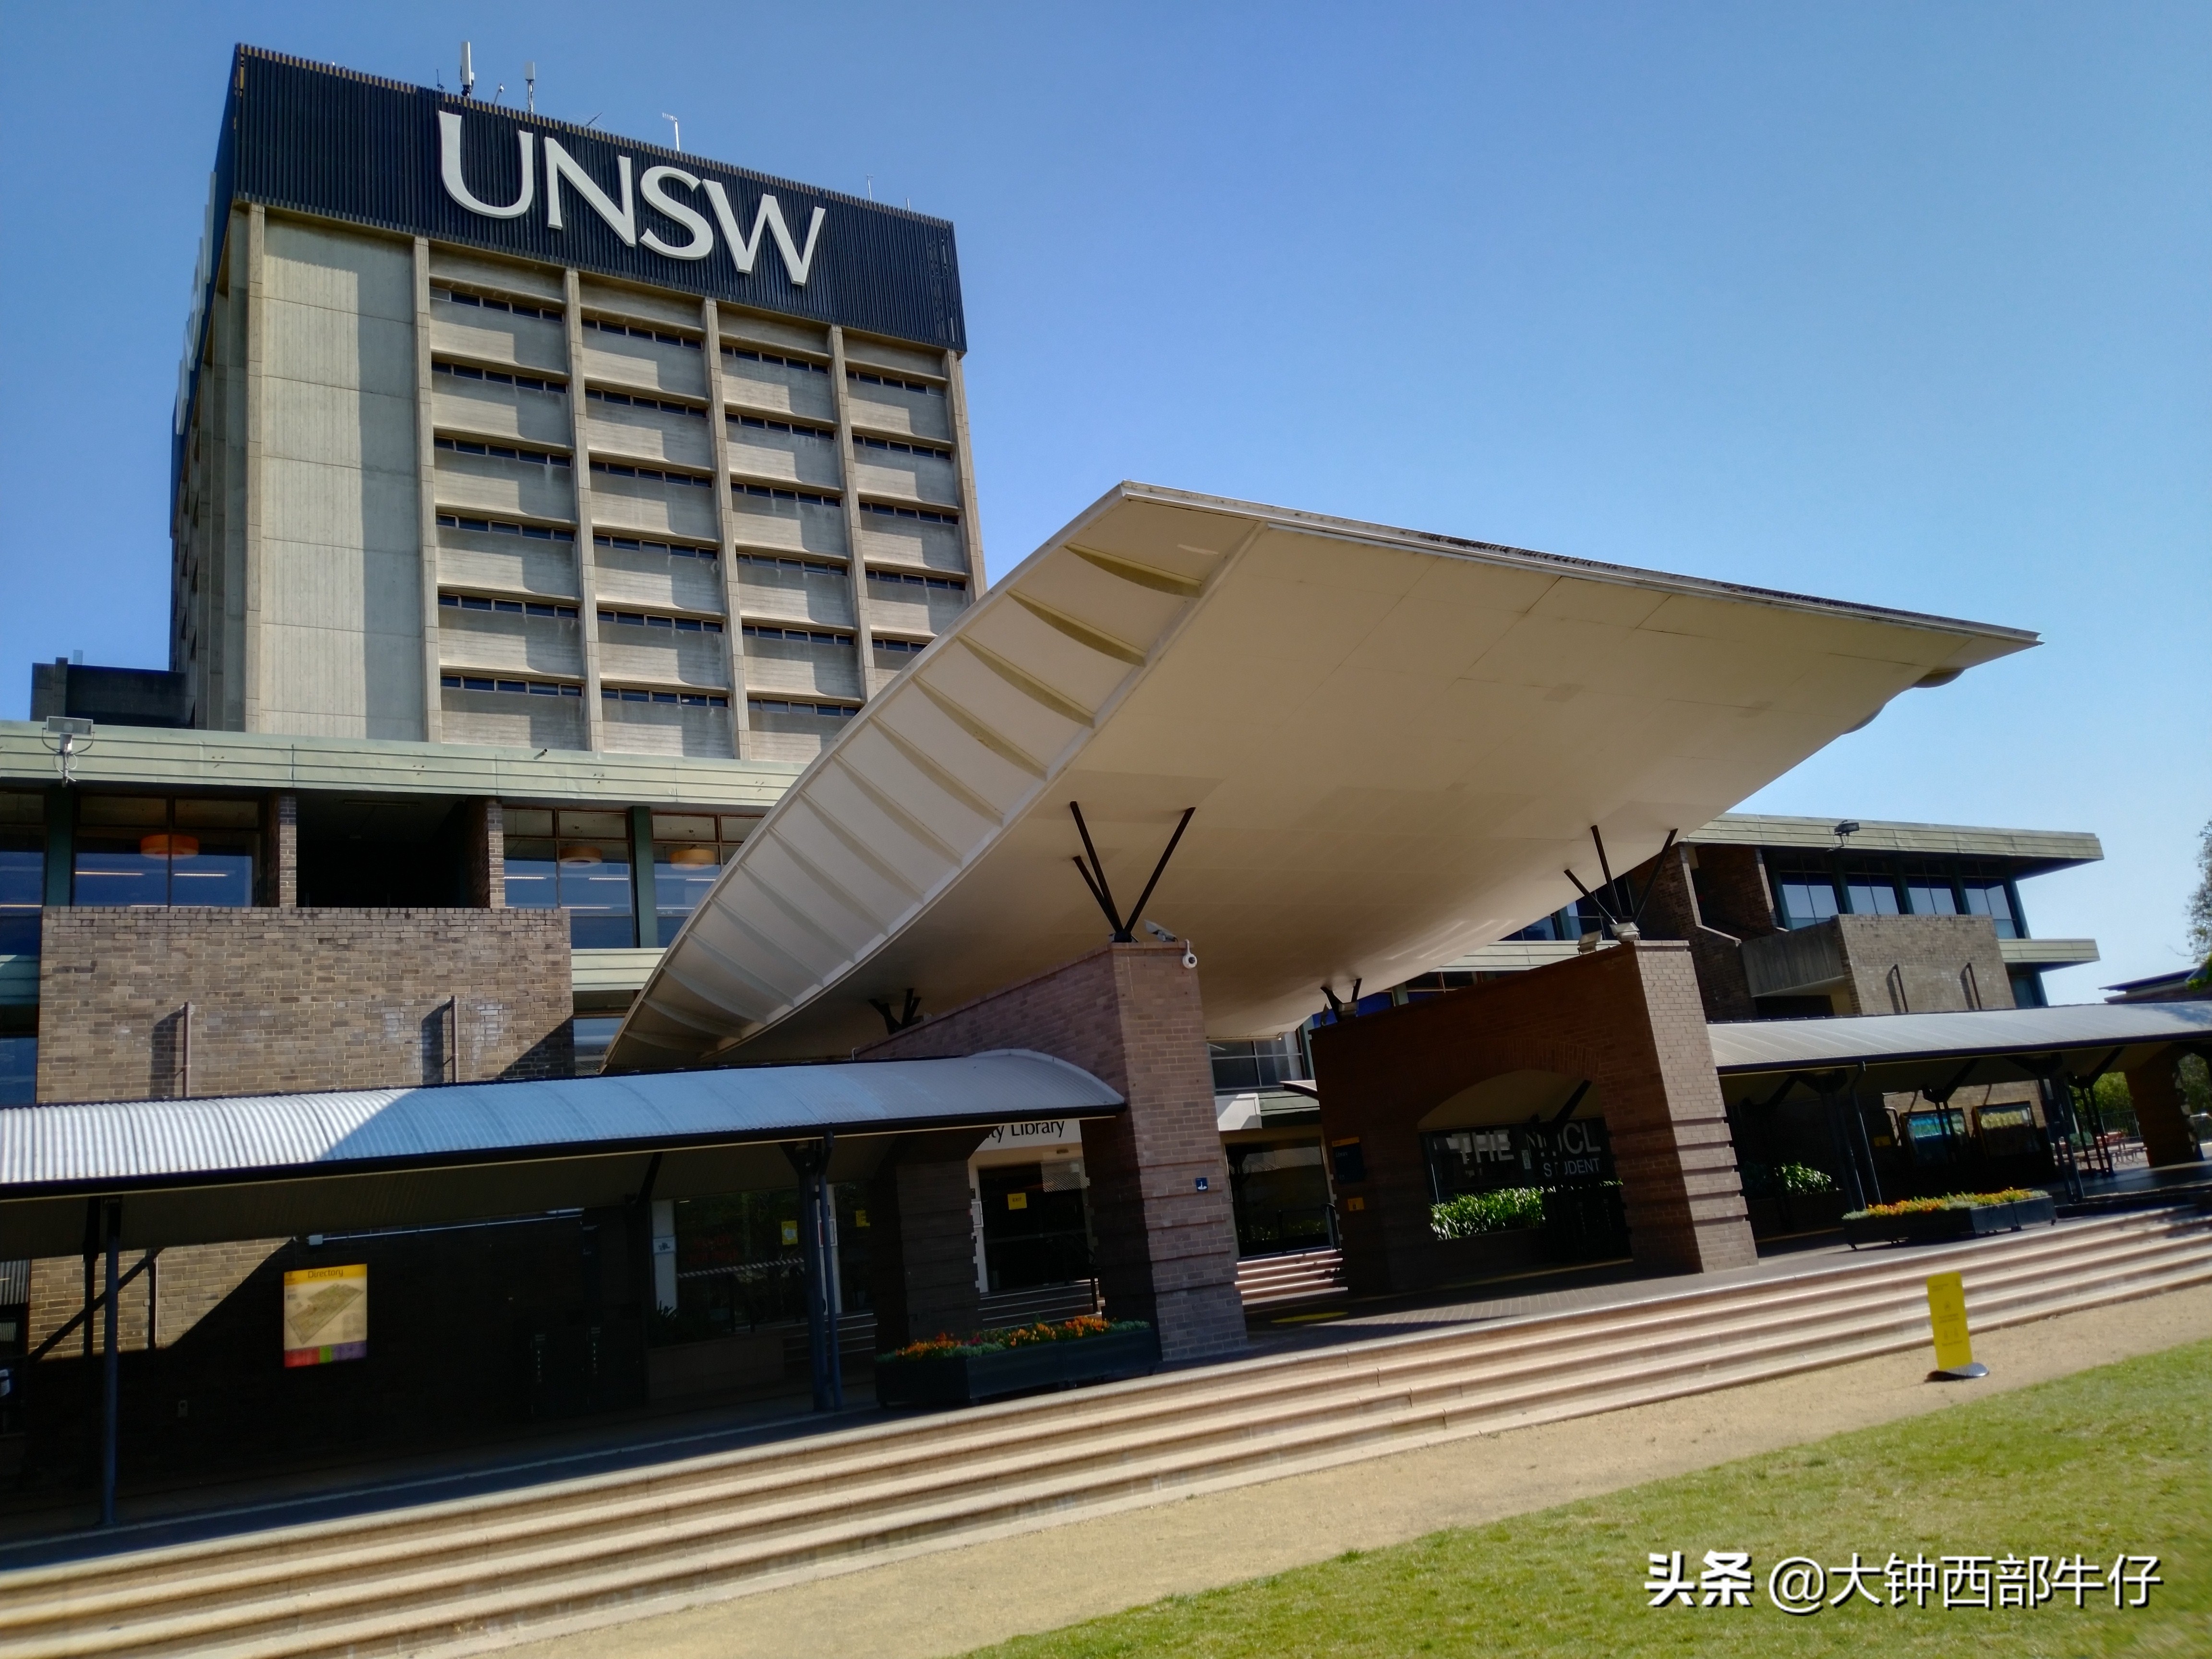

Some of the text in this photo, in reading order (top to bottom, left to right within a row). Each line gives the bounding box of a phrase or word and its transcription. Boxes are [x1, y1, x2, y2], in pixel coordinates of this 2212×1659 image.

[438, 110, 826, 286] UNSW
[1011, 1121, 1065, 1137] Library
[1451, 1129, 1515, 1165] THE
[308, 1269, 343, 1278] Directory
